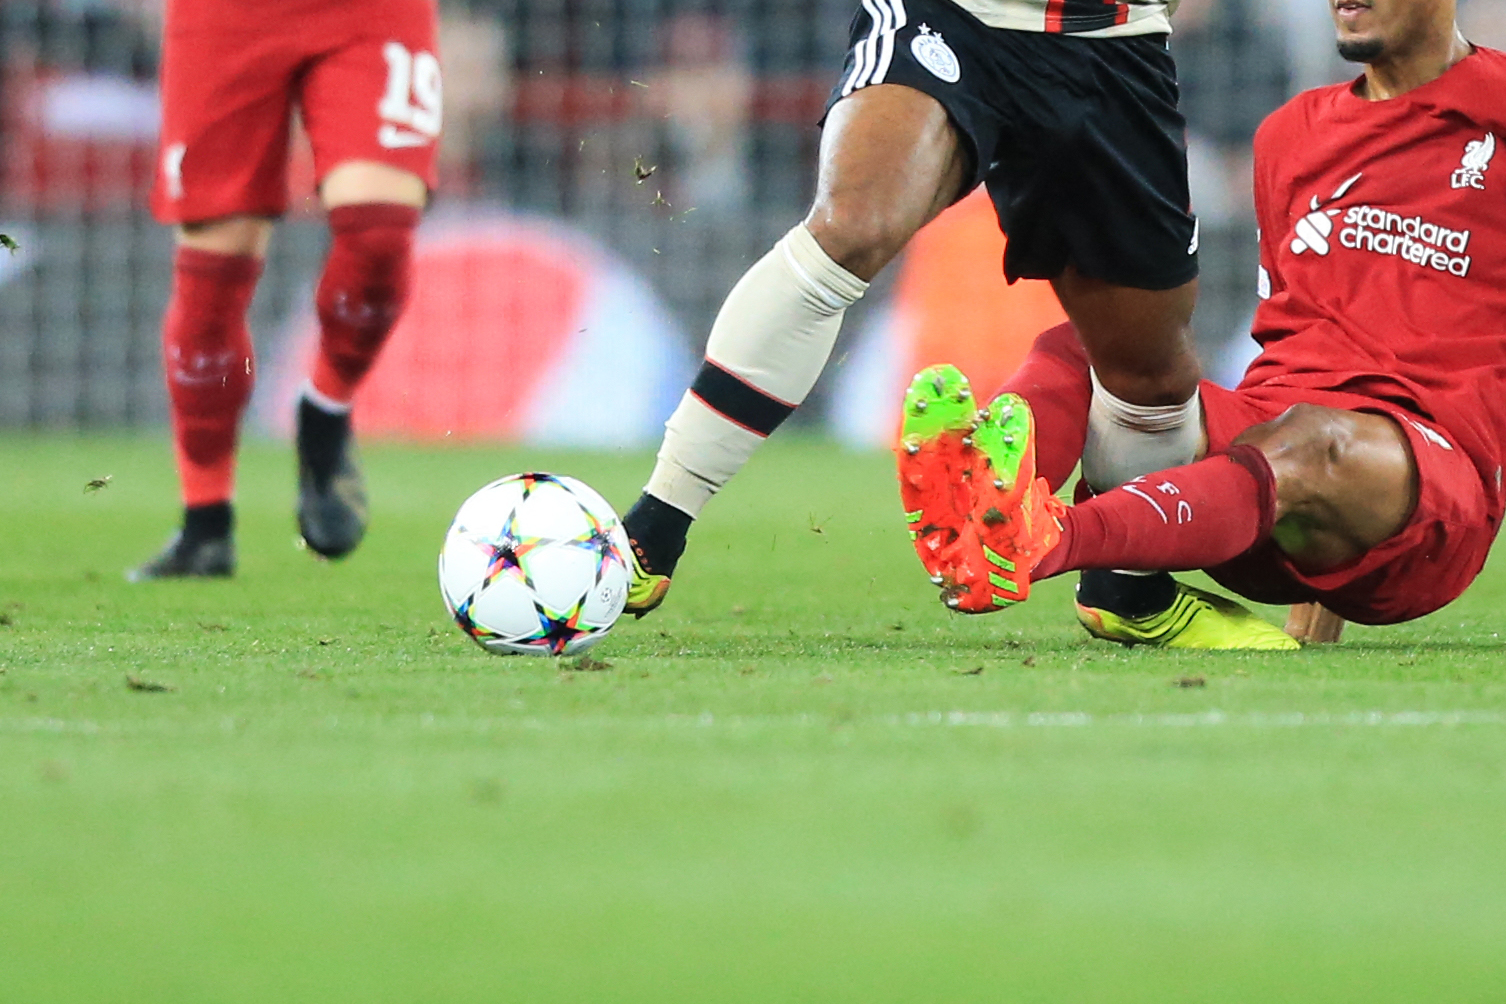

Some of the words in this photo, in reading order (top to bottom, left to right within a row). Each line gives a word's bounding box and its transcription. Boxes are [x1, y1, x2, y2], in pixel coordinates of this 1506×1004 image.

[379, 41, 442, 135] 19
[1340, 226, 1471, 278] chartered
[1343, 206, 1470, 254] standard
